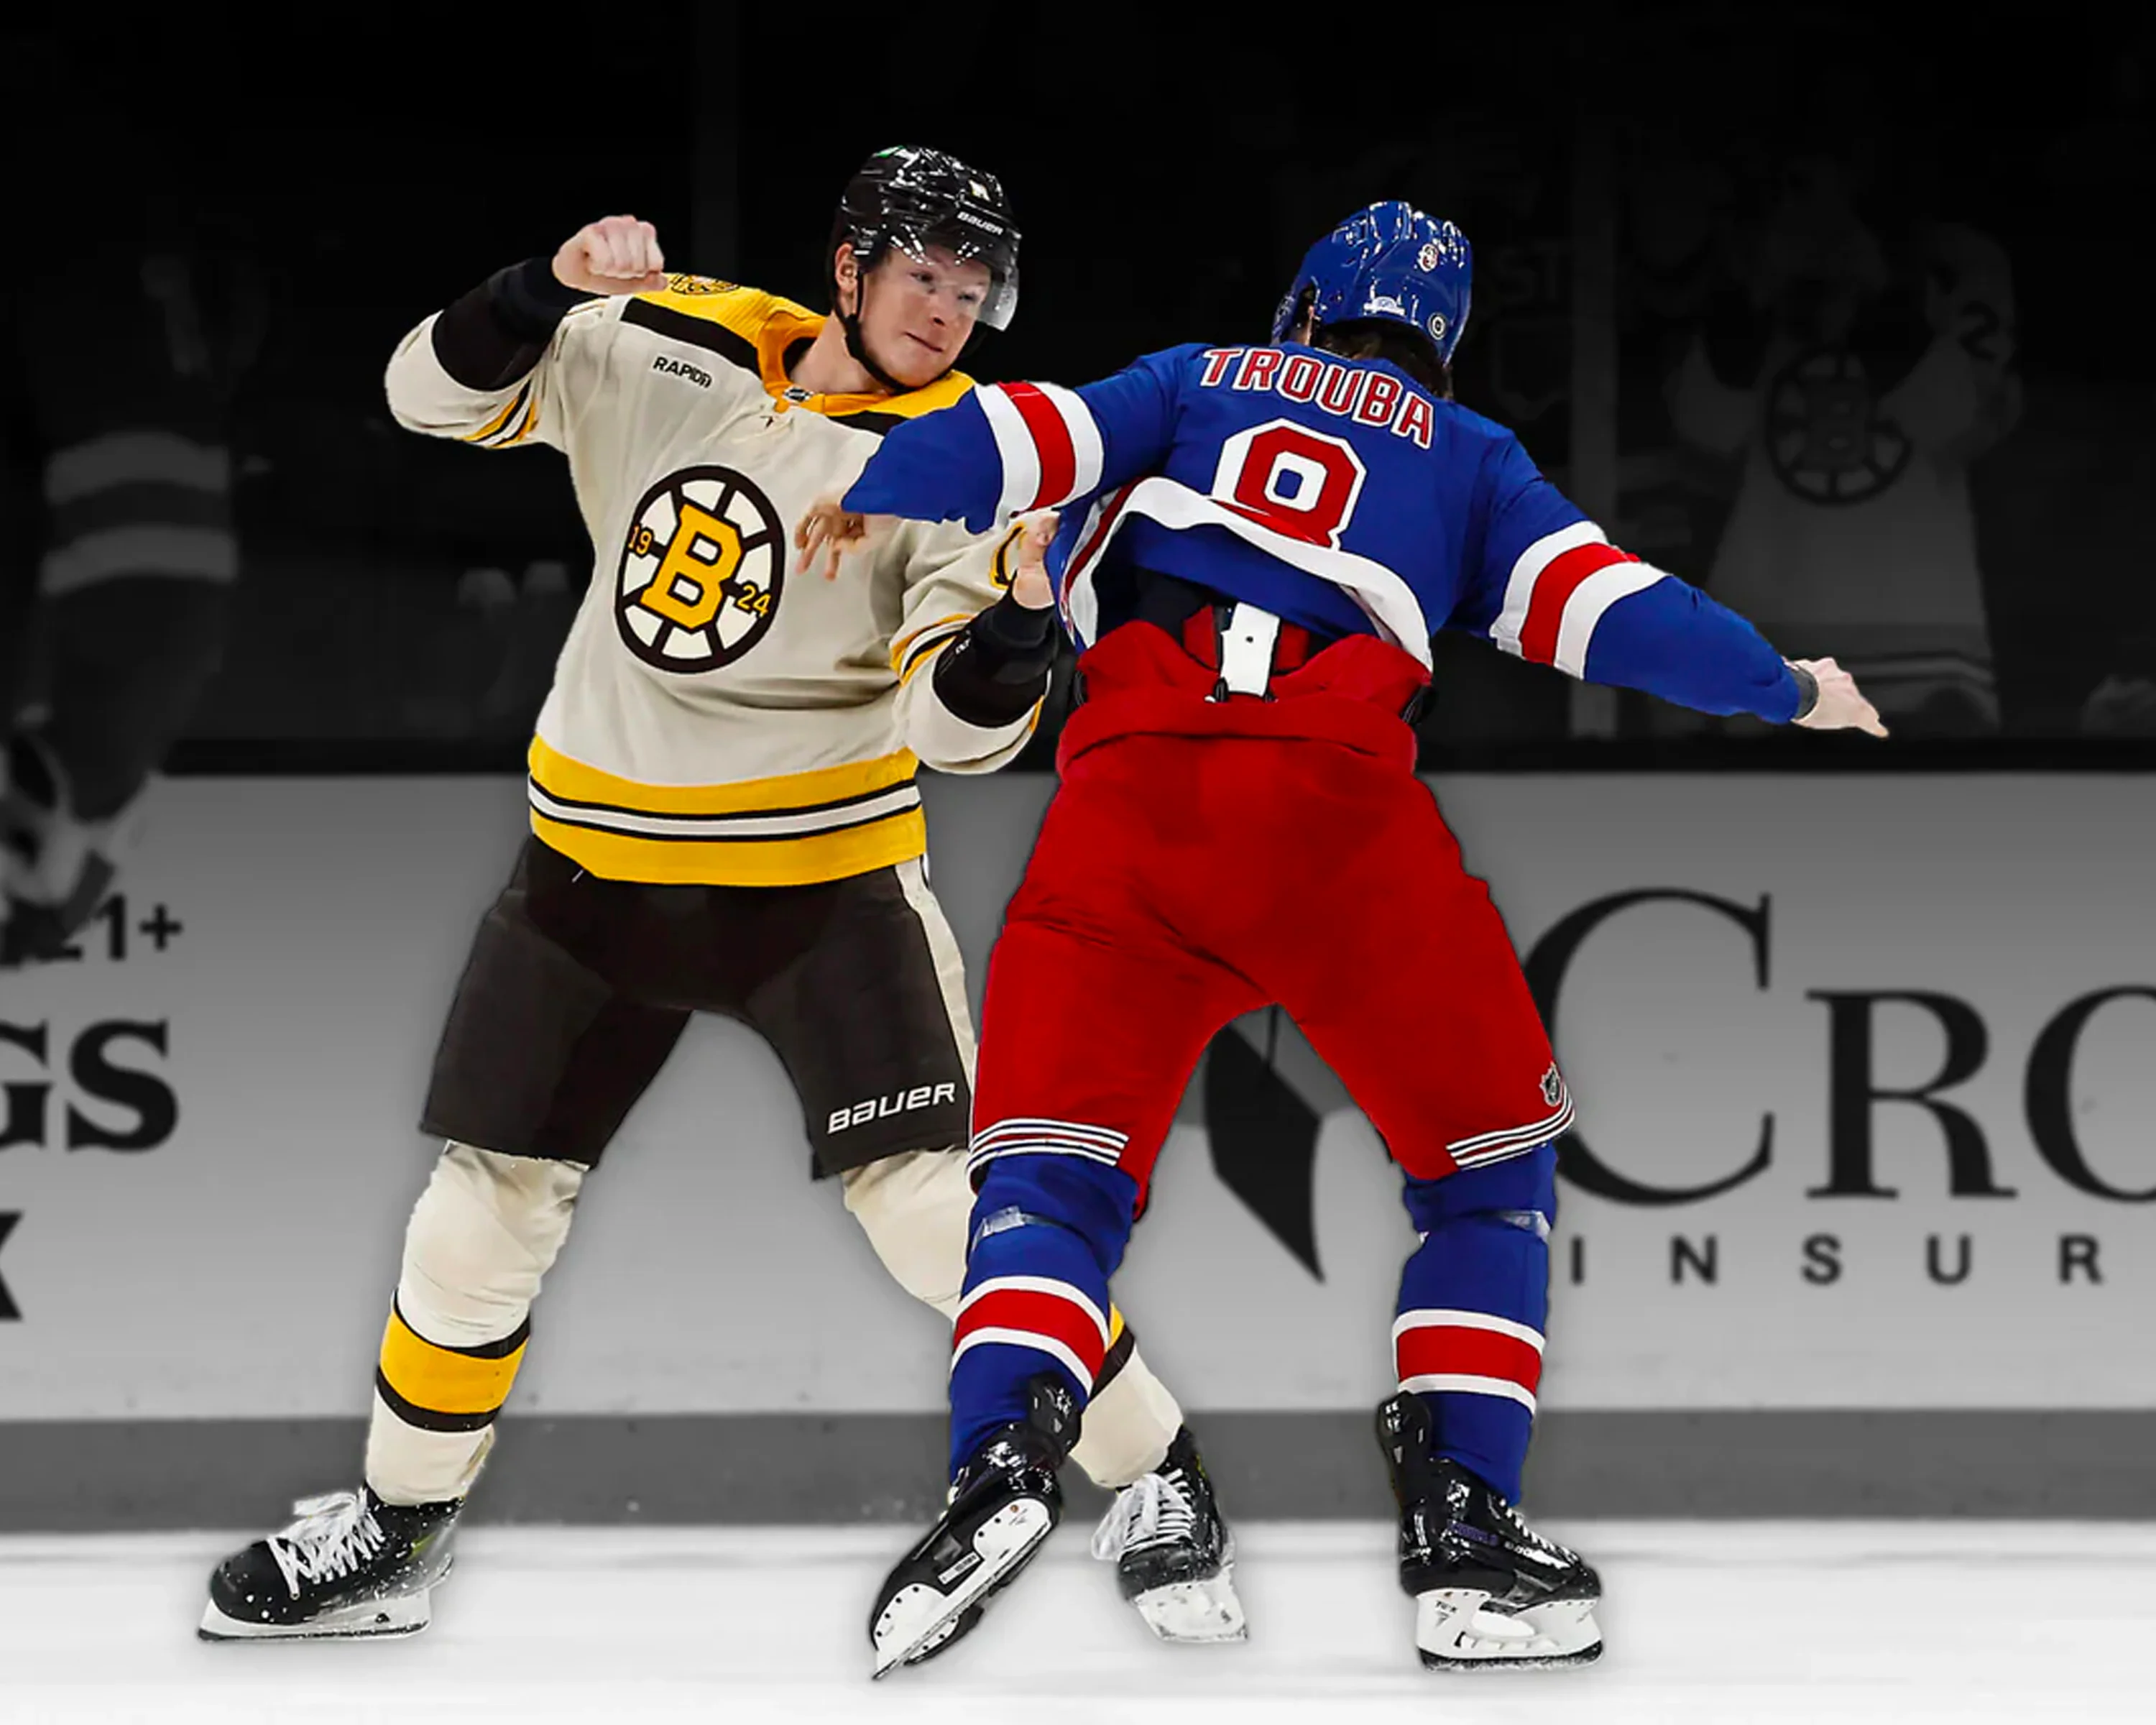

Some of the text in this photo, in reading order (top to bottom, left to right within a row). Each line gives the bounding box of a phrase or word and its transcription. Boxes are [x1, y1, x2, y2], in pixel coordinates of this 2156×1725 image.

[957, 211, 1004, 236] BAUER
[1200, 347, 1434, 450] TROUBA
[628, 503, 772, 630] 19 B 24
[828, 1082, 955, 1134] BAUER
[1570, 1233, 2104, 1287] INSUR
